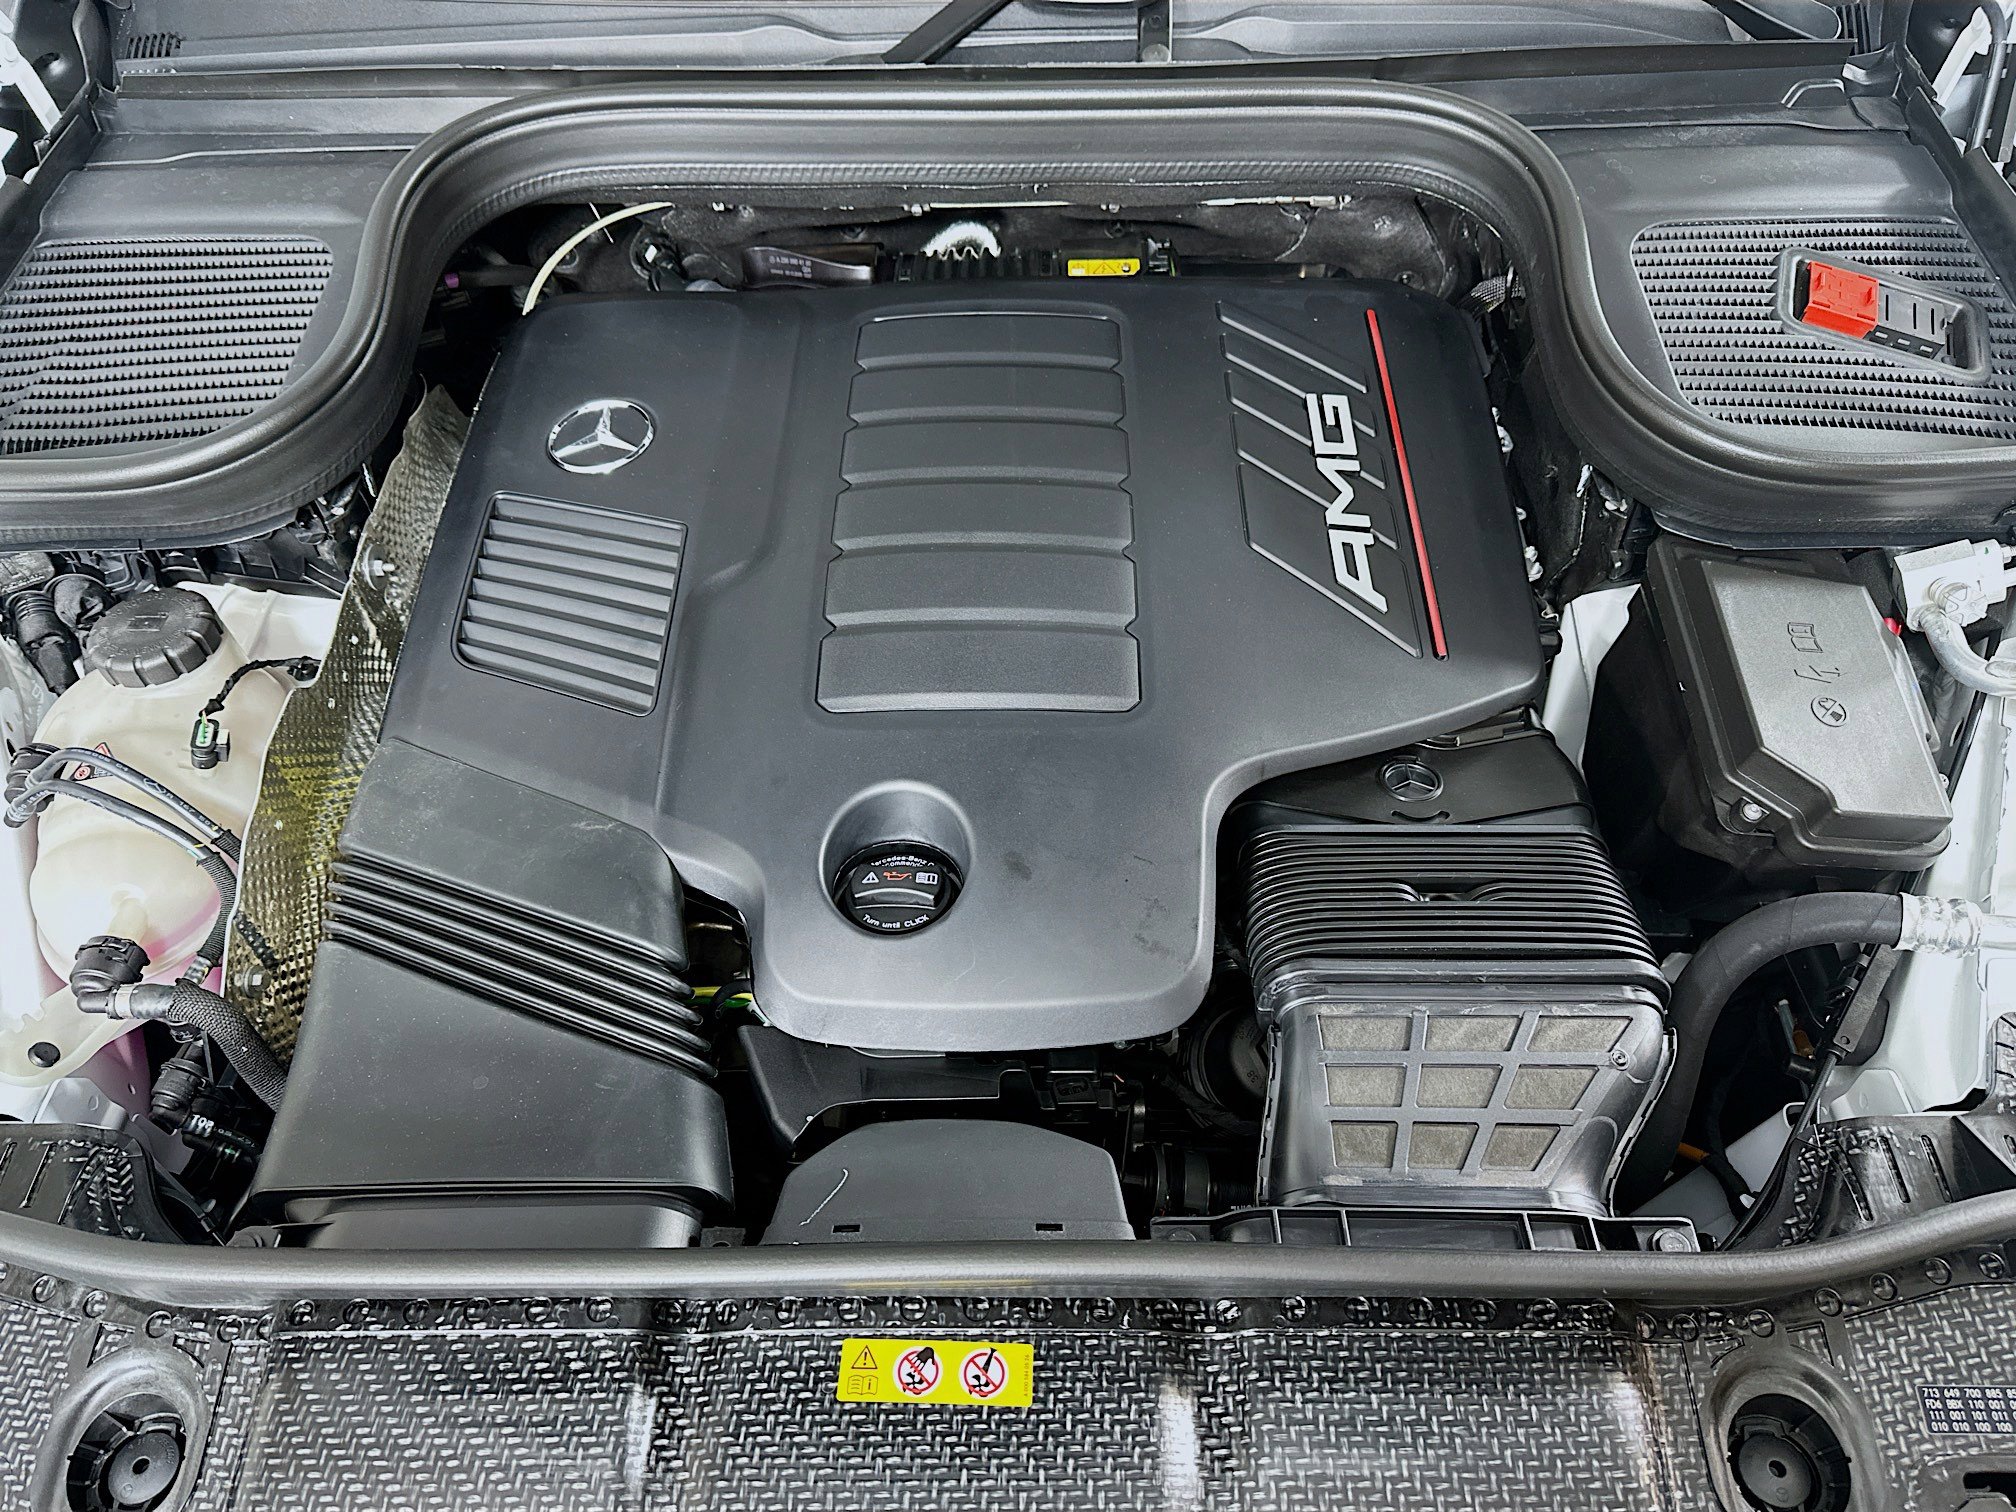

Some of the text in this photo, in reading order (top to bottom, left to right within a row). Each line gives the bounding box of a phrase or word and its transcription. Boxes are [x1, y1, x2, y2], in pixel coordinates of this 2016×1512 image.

[1306, 393, 1388, 614] AMG
[862, 914, 930, 929] Turn until CLICK
[1922, 1388, 1940, 1398] 713
[1944, 1388, 1960, 1398] 649
[1964, 1388, 1982, 1398] 700
[1968, 1400, 1985, 1409] 110
[1988, 1400, 2006, 1410] 001
[1929, 1411, 1946, 1420] 111
[1949, 1411, 1967, 1420] 001
[1971, 1411, 1988, 1420] 101
[1991, 1411, 2009, 1420] 011
[1931, 1422, 2014, 1432] 010 010 100 100
